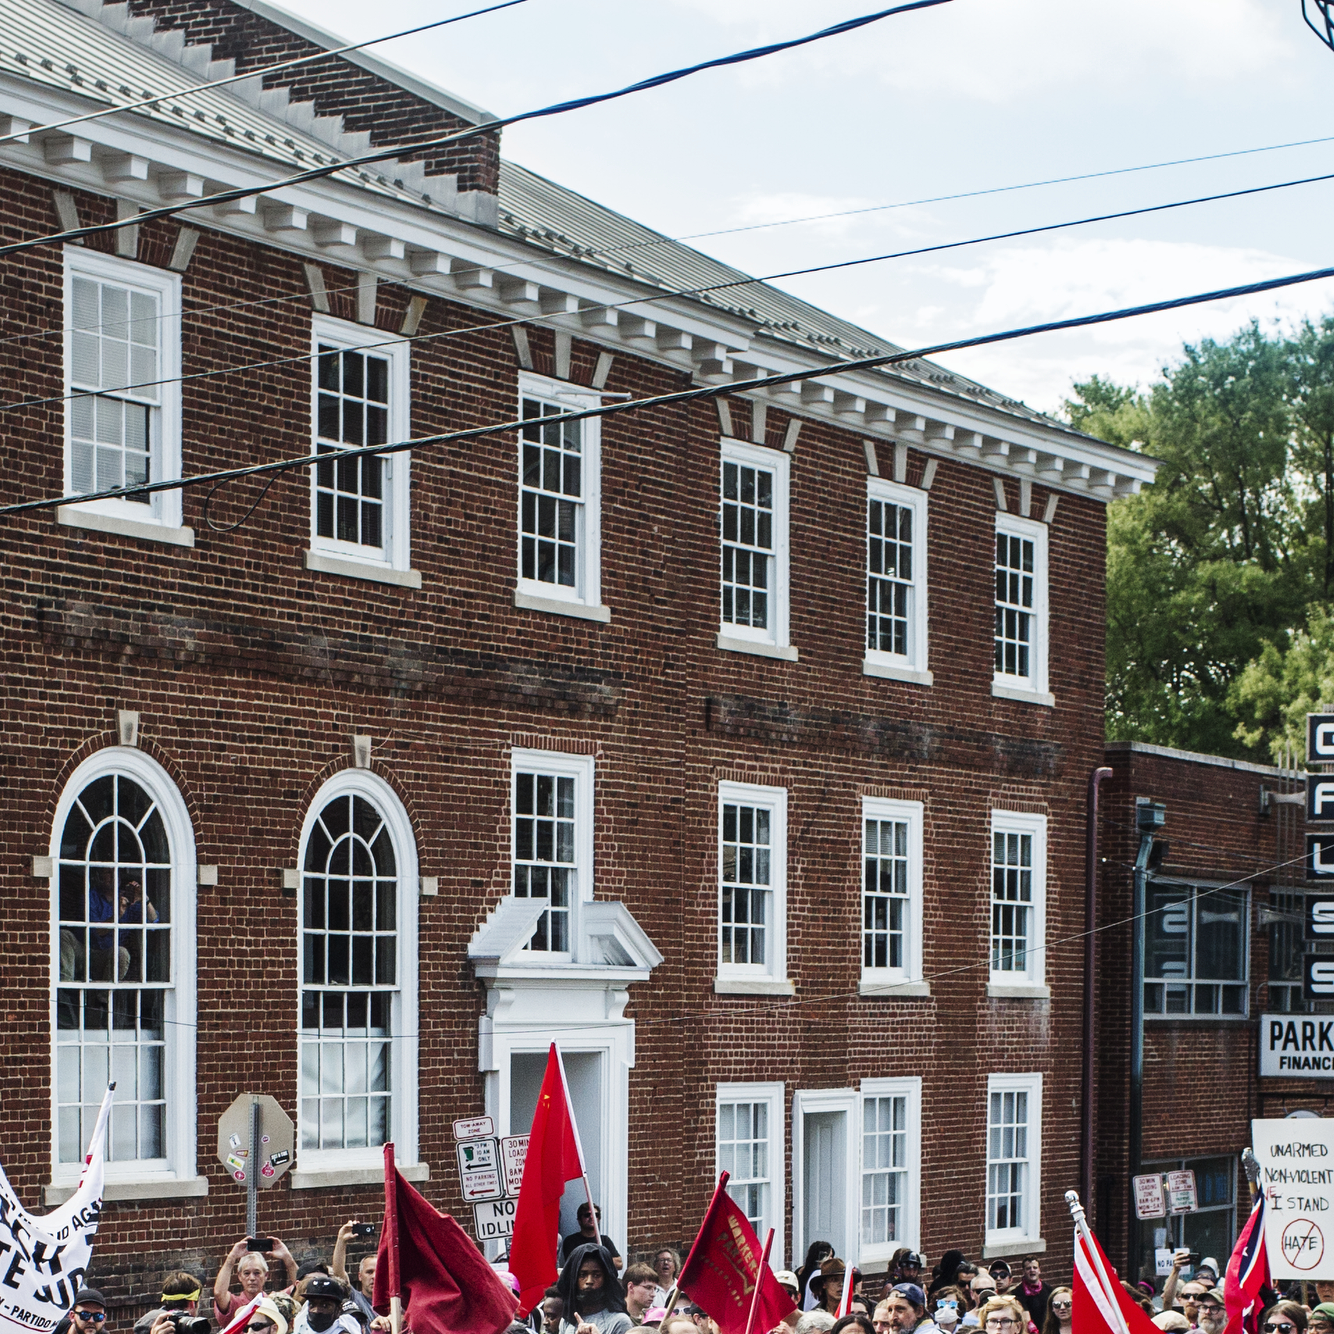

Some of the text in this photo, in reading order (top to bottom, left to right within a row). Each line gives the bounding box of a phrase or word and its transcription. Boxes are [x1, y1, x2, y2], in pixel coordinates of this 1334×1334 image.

[508, 1148, 528, 1158] LOADI
[1270, 1142, 1329, 1158] UNARMED
[515, 1158, 526, 1166] ZON
[474, 1173, 496, 1181] PARKING
[1264, 1167, 1334, 1184] NON-VIOLENT
[493, 1201, 515, 1217] NO
[1287, 1197, 1330, 1212] STAND
[482, 1220, 516, 1236] IDLI
[1284, 1236, 1318, 1251] HATE
